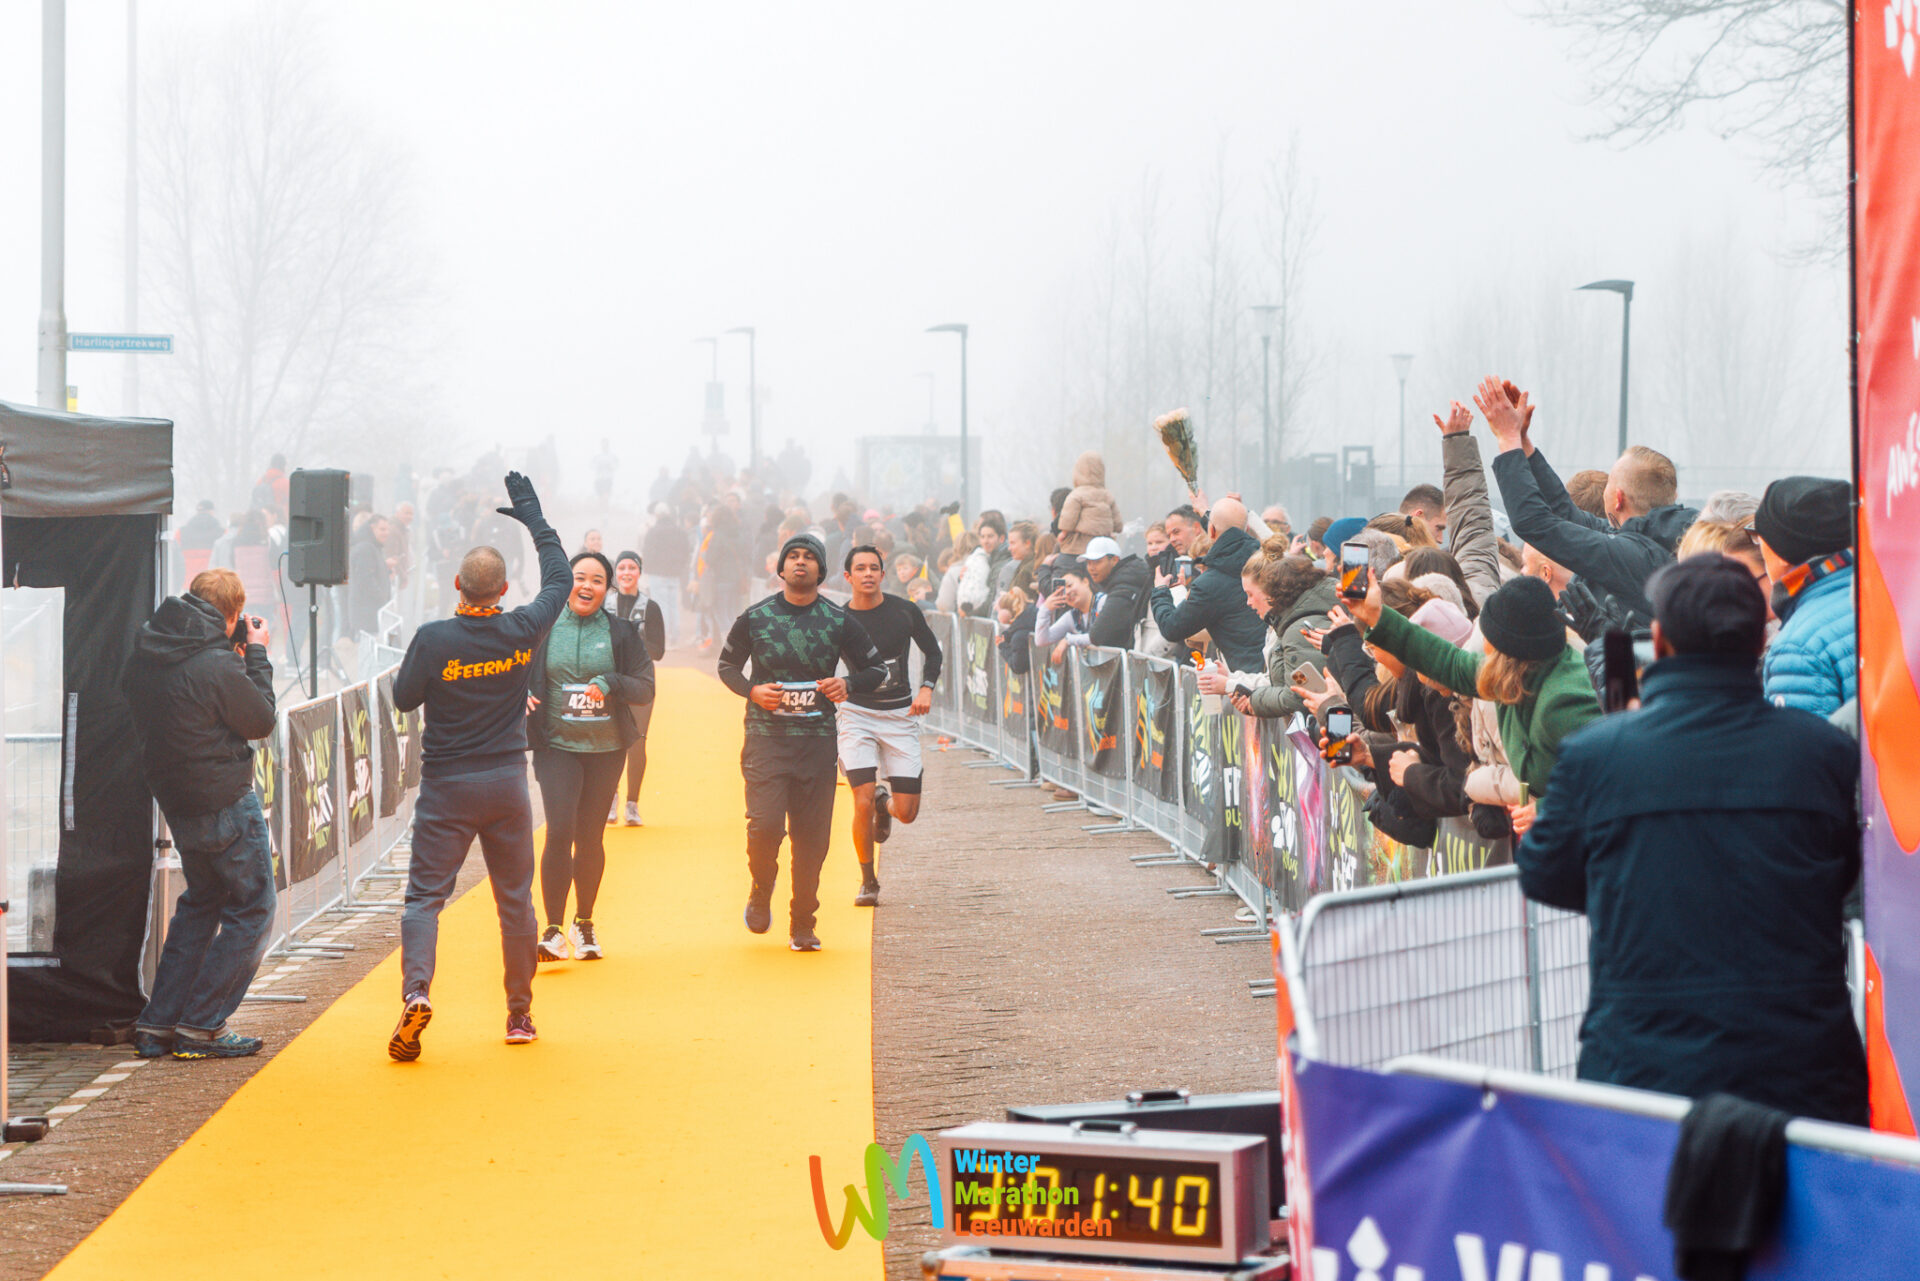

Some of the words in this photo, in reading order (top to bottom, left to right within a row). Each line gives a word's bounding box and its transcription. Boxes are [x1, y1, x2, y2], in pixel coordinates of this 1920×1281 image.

[75, 338, 168, 350] Harlingertrekweg
[447, 659, 460, 669] DE
[781, 690, 816, 707] 4342
